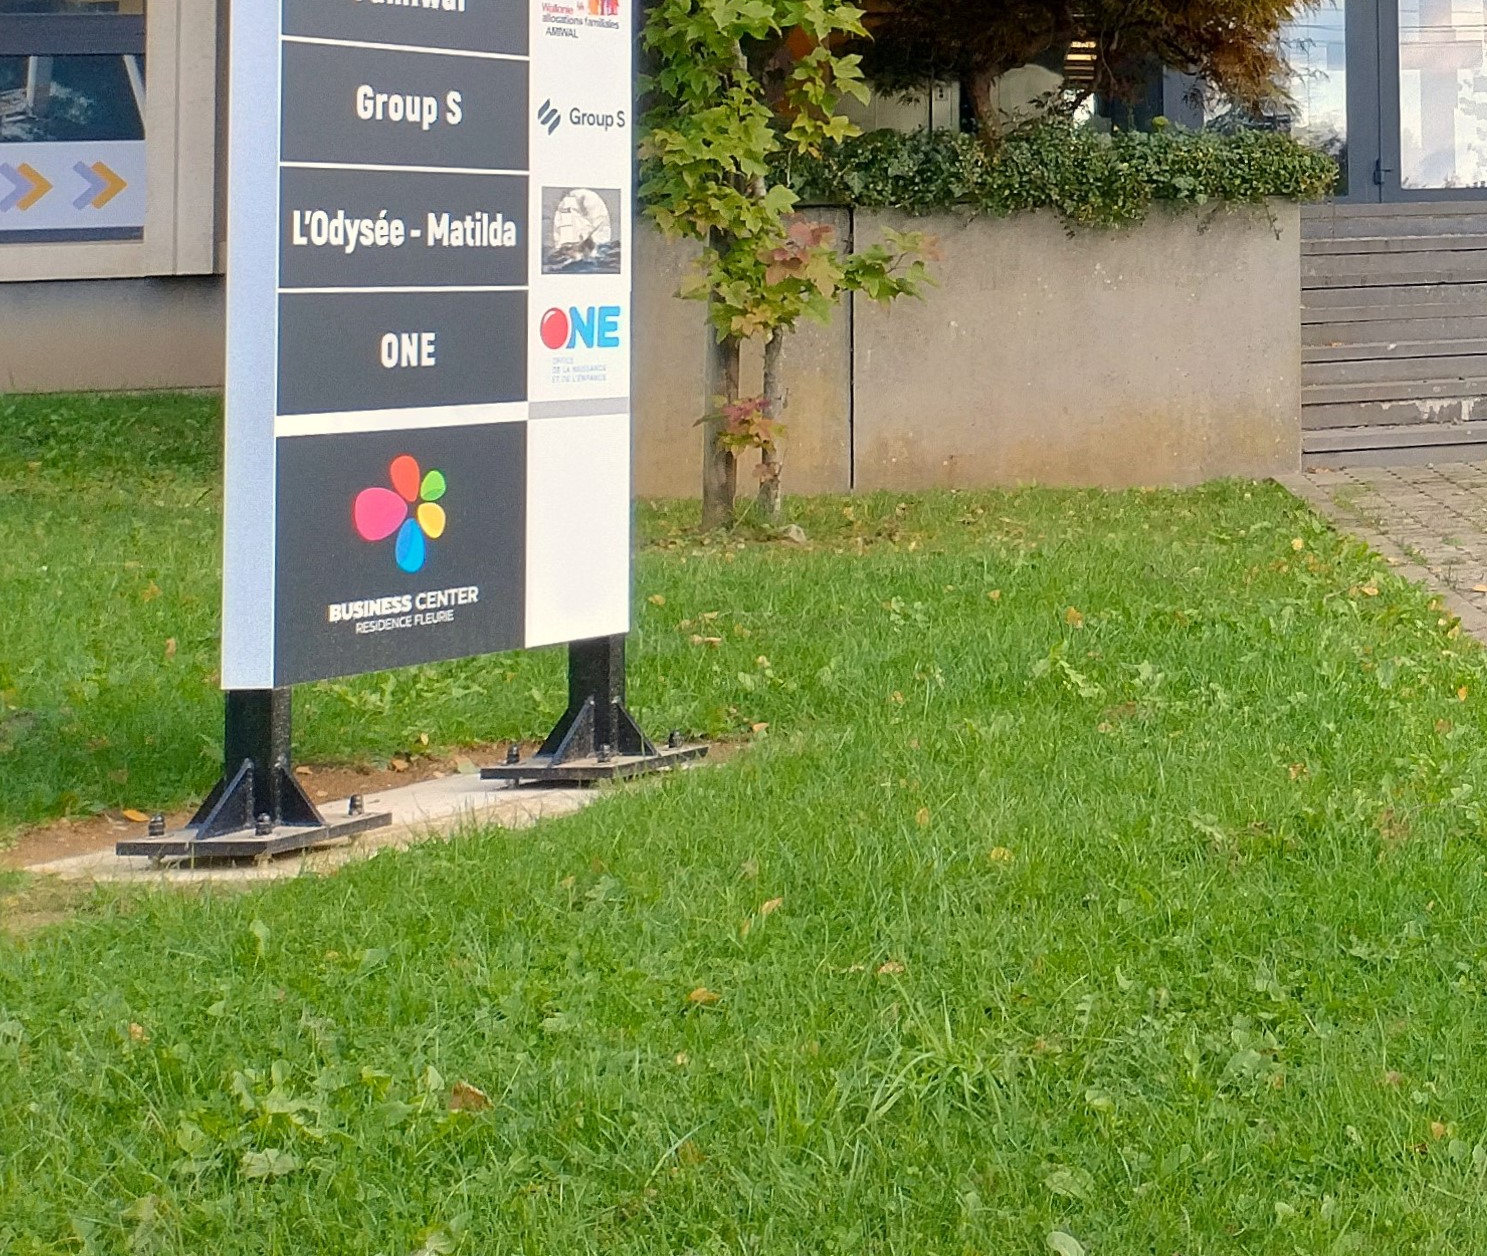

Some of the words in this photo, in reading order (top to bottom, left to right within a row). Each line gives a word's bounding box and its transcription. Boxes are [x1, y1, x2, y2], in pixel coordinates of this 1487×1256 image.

[356, 84, 438, 131] Group
[446, 90, 463, 125] S
[569, 107, 614, 131] Group
[617, 110, 626, 128] S
[293, 209, 405, 253] L'Odysée
[410, 229, 421, 238] -
[427, 212, 517, 247] Matilda
[540, 306, 621, 350] ONE
[380, 332, 436, 368] ONE
[327, 594, 413, 623] BUSINESS
[415, 586, 479, 611] CENTER
[355, 614, 413, 634] RESIDENCE
[414, 609, 454, 626] FLEURIE
